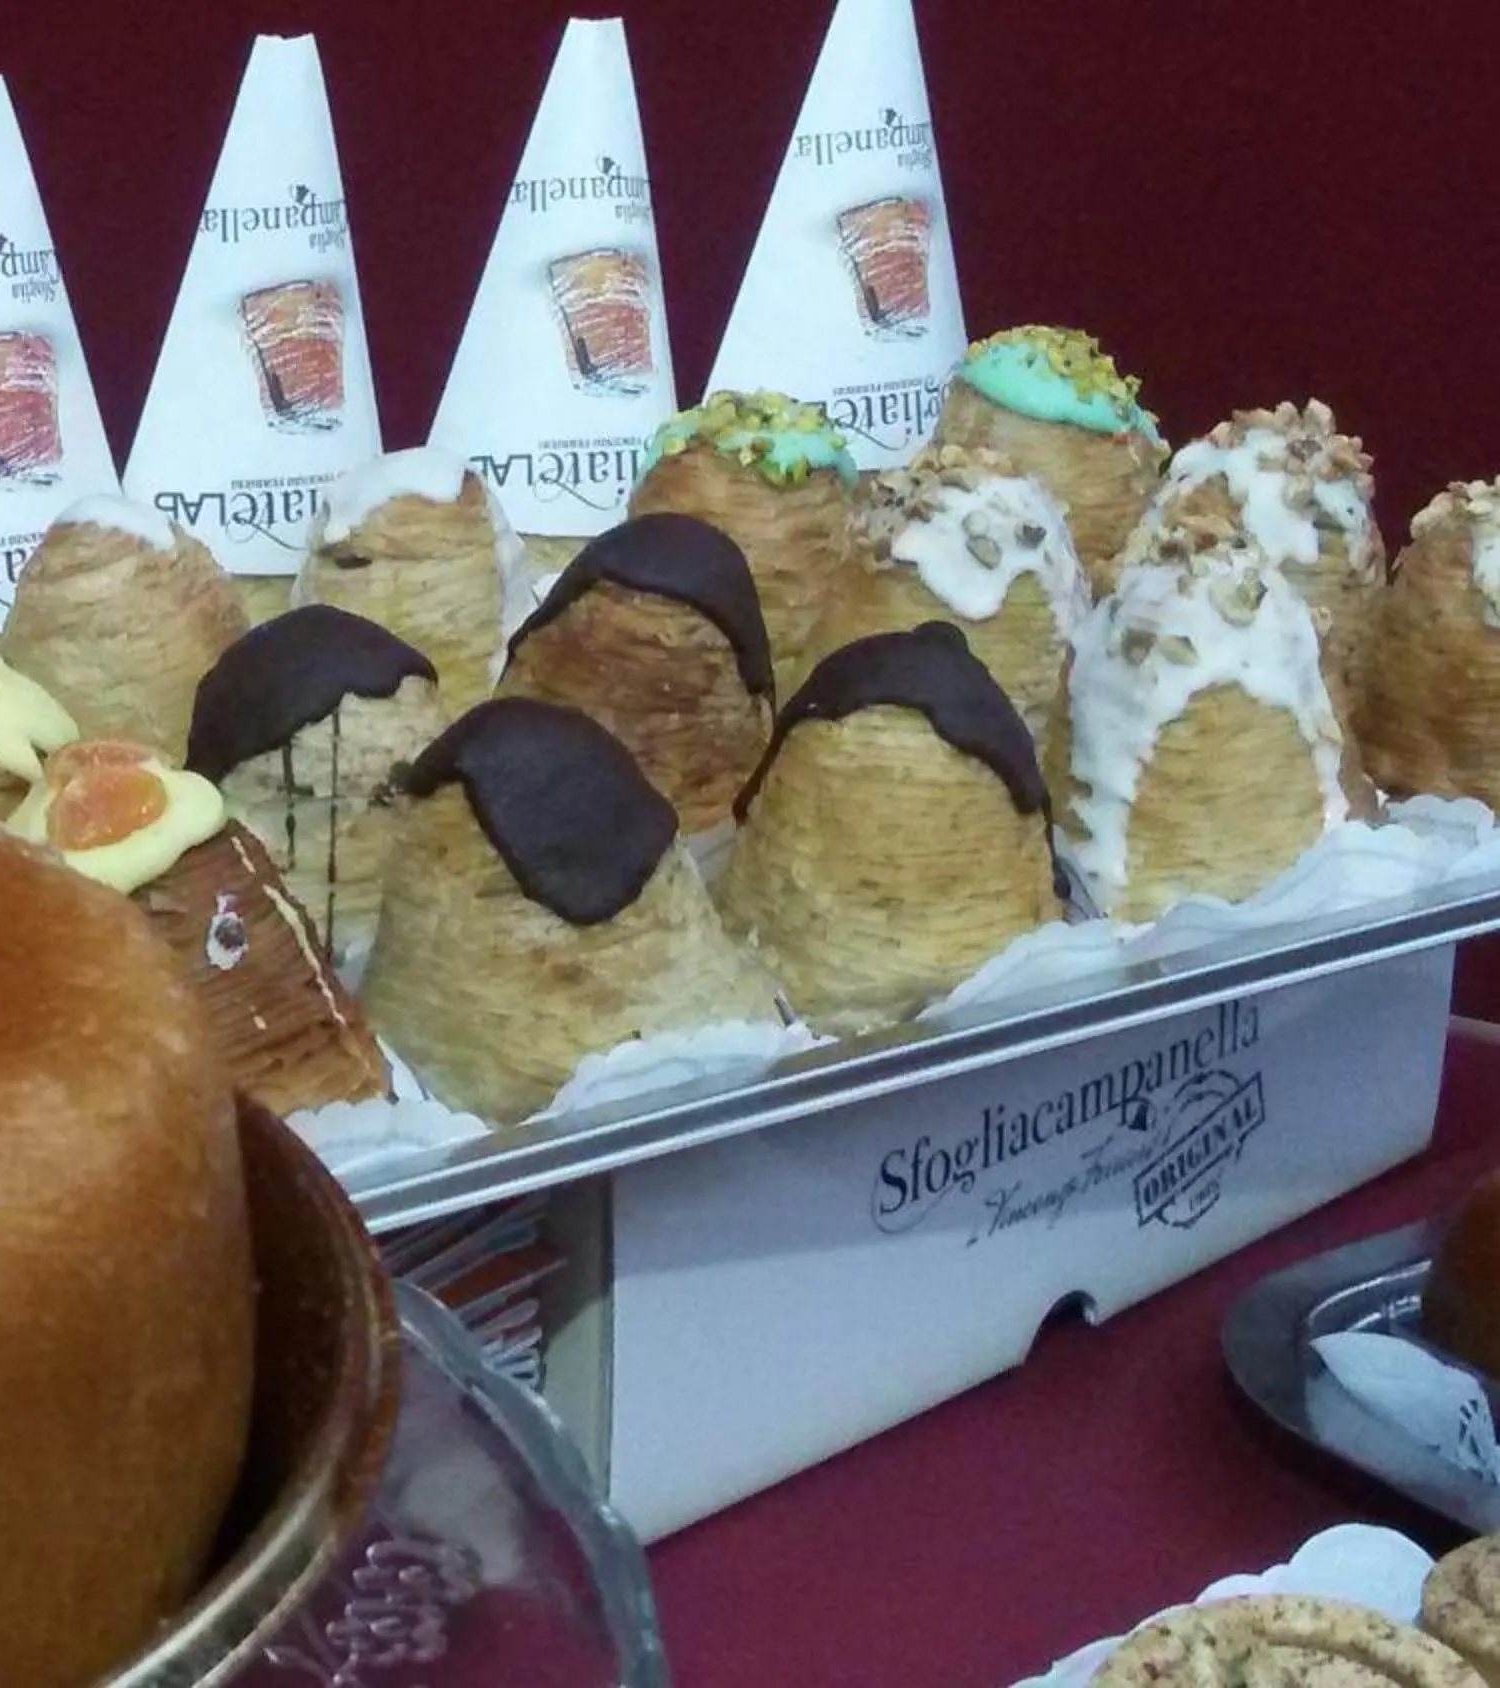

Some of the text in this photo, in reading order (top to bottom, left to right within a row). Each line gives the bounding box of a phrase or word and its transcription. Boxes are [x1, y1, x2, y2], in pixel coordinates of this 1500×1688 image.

[514, 165, 649, 212] mpanella
[874, 1000, 1260, 1226] Sfogliacampanella
[1142, 1096, 1259, 1207] ORIGINAL
